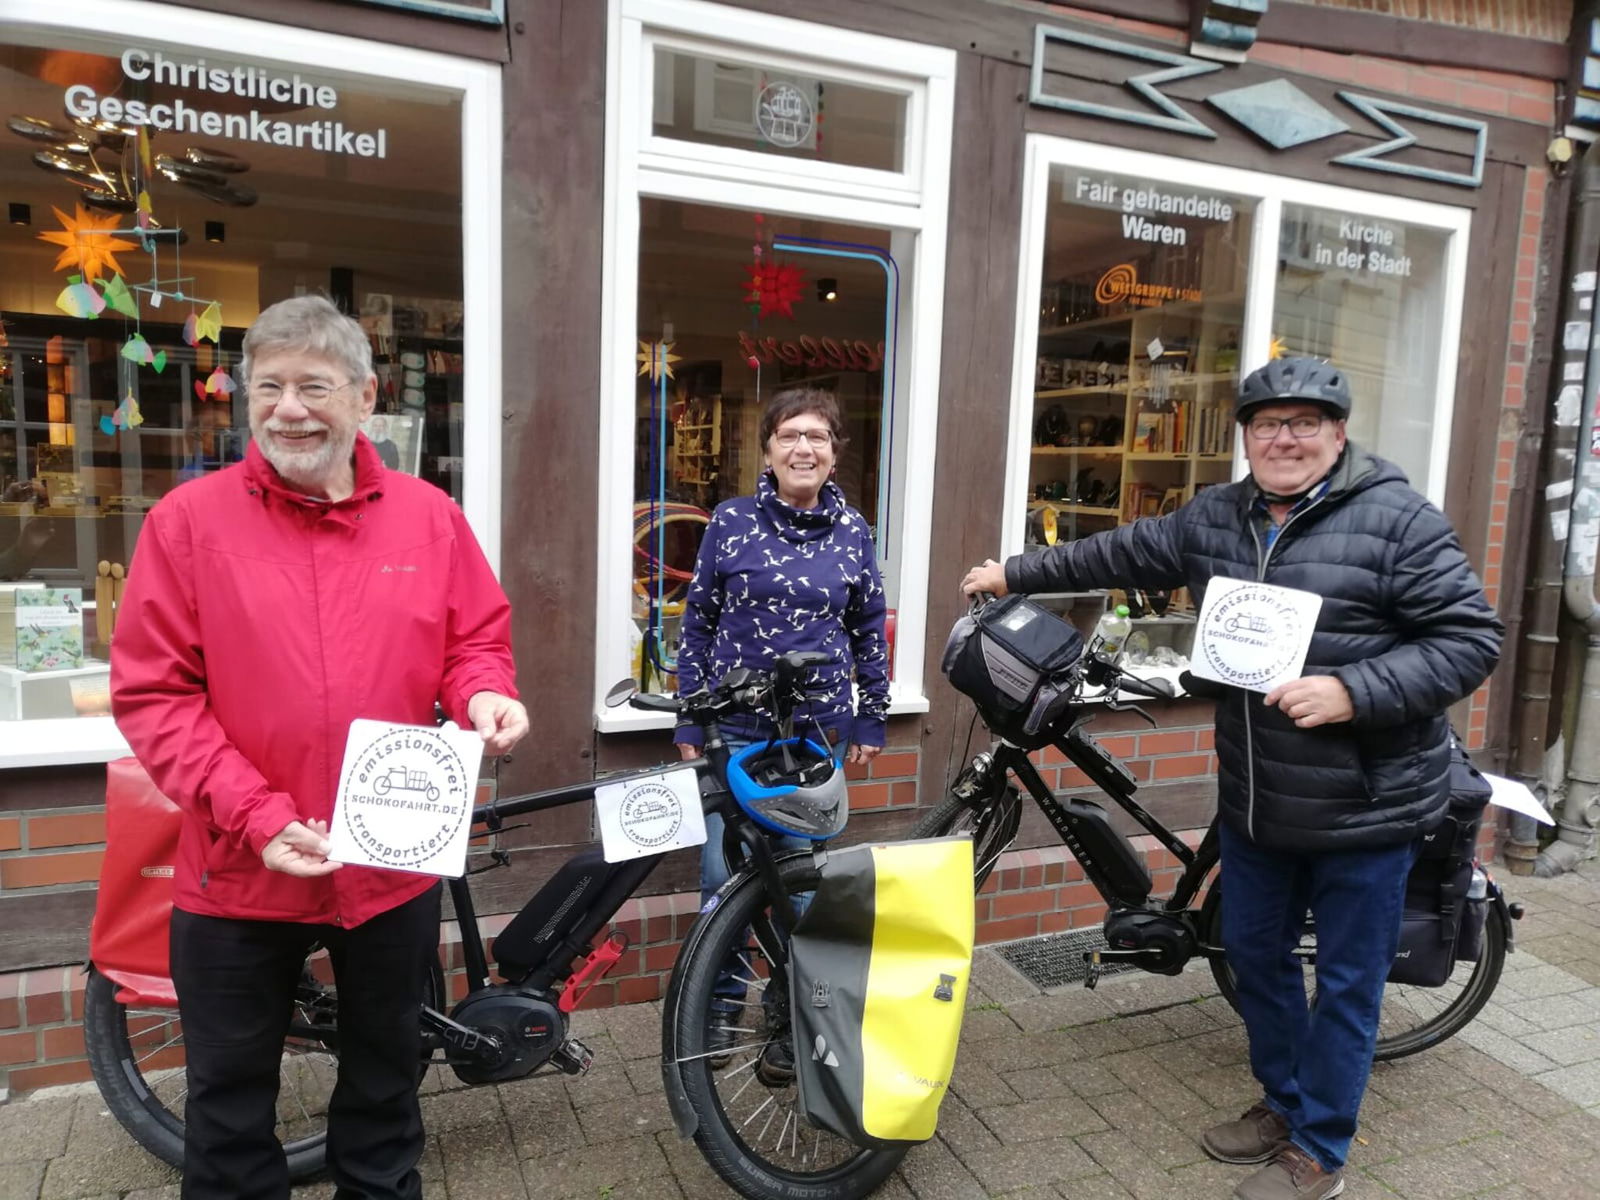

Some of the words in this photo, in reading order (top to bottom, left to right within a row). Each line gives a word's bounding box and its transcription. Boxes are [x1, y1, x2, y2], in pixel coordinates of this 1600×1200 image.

[120, 47, 338, 110] Christliche
[64, 84, 387, 159] Geschenkartikel
[1075, 177, 1117, 204] Fair
[1122, 186, 1232, 221] gehandelte
[1121, 215, 1187, 246] Waren
[1338, 218, 1394, 246] Kirche
[1315, 244, 1333, 265] in
[1336, 246, 1365, 270] der
[1368, 250, 1412, 277] Stadt
[359, 734, 463, 795] emissionsfrei
[351, 794, 459, 815] SCHOKOFAHRT.DE
[353, 813, 451, 859] transportiert
[628, 820, 678, 844] transportiert
[1042, 797, 1092, 866] WANDERER
[738, 1156, 784, 1192] SUPER
